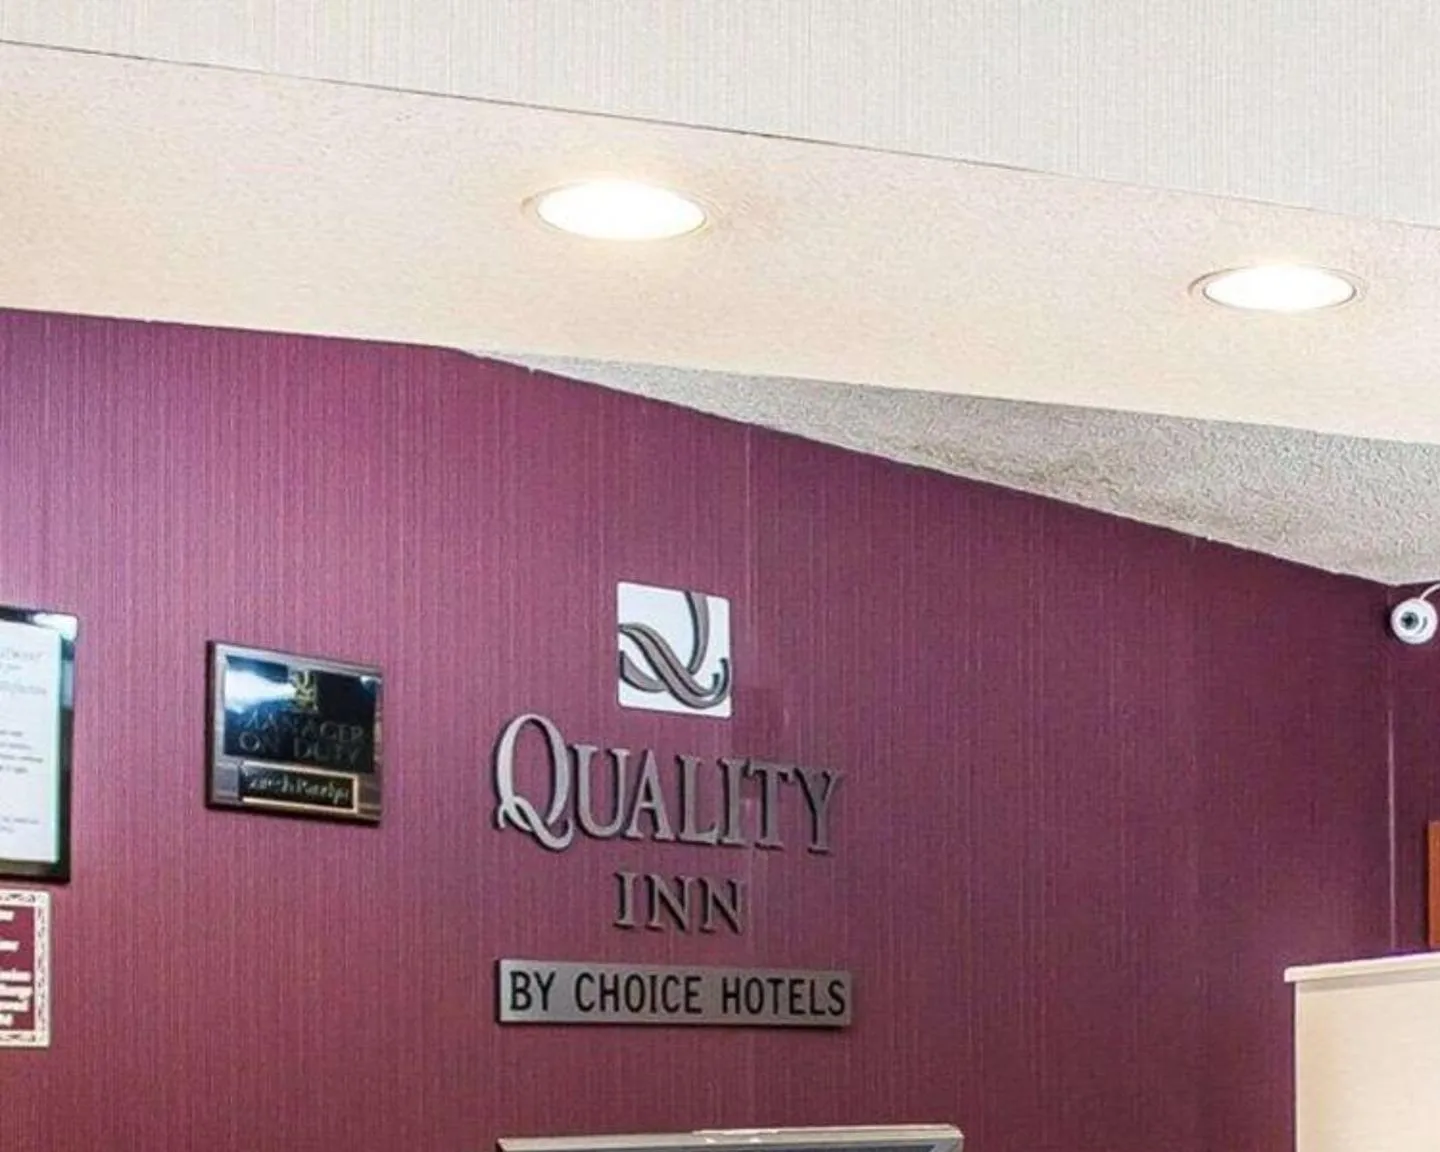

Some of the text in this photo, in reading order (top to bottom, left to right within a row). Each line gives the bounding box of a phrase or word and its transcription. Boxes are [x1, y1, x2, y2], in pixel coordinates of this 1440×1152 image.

[494, 713, 843, 854] QUALITY
[613, 871, 747, 933] INN
[509, 971, 846, 1017] BY CHOICE HOTELS
